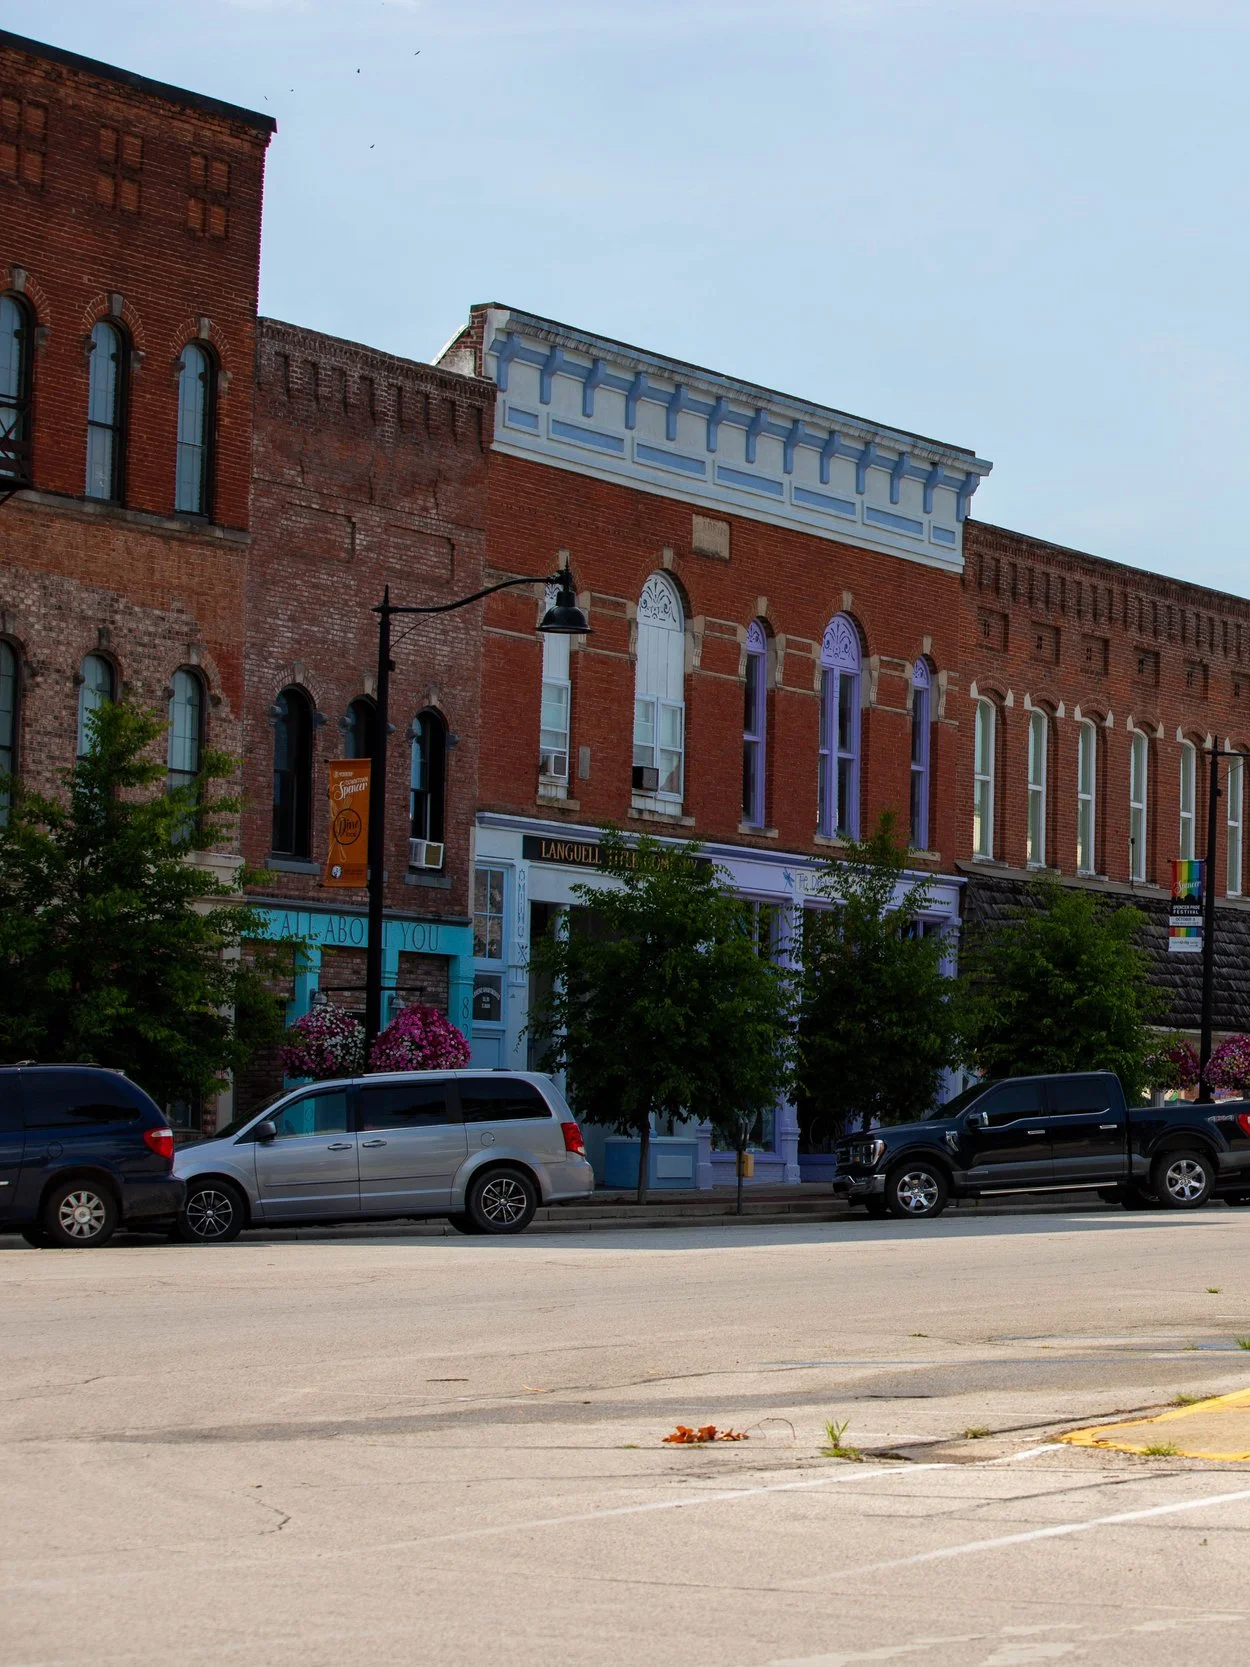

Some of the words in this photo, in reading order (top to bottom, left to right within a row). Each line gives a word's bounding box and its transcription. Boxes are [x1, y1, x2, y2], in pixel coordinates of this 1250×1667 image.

[332, 780, 368, 801] Spencer
[540, 840, 602, 864] LANGUELL
[1173, 879, 1202, 894] Spencer
[279, 911, 318, 941] ALL
[324, 915, 392, 948] ABOT
[400, 922, 440, 951] YOU
